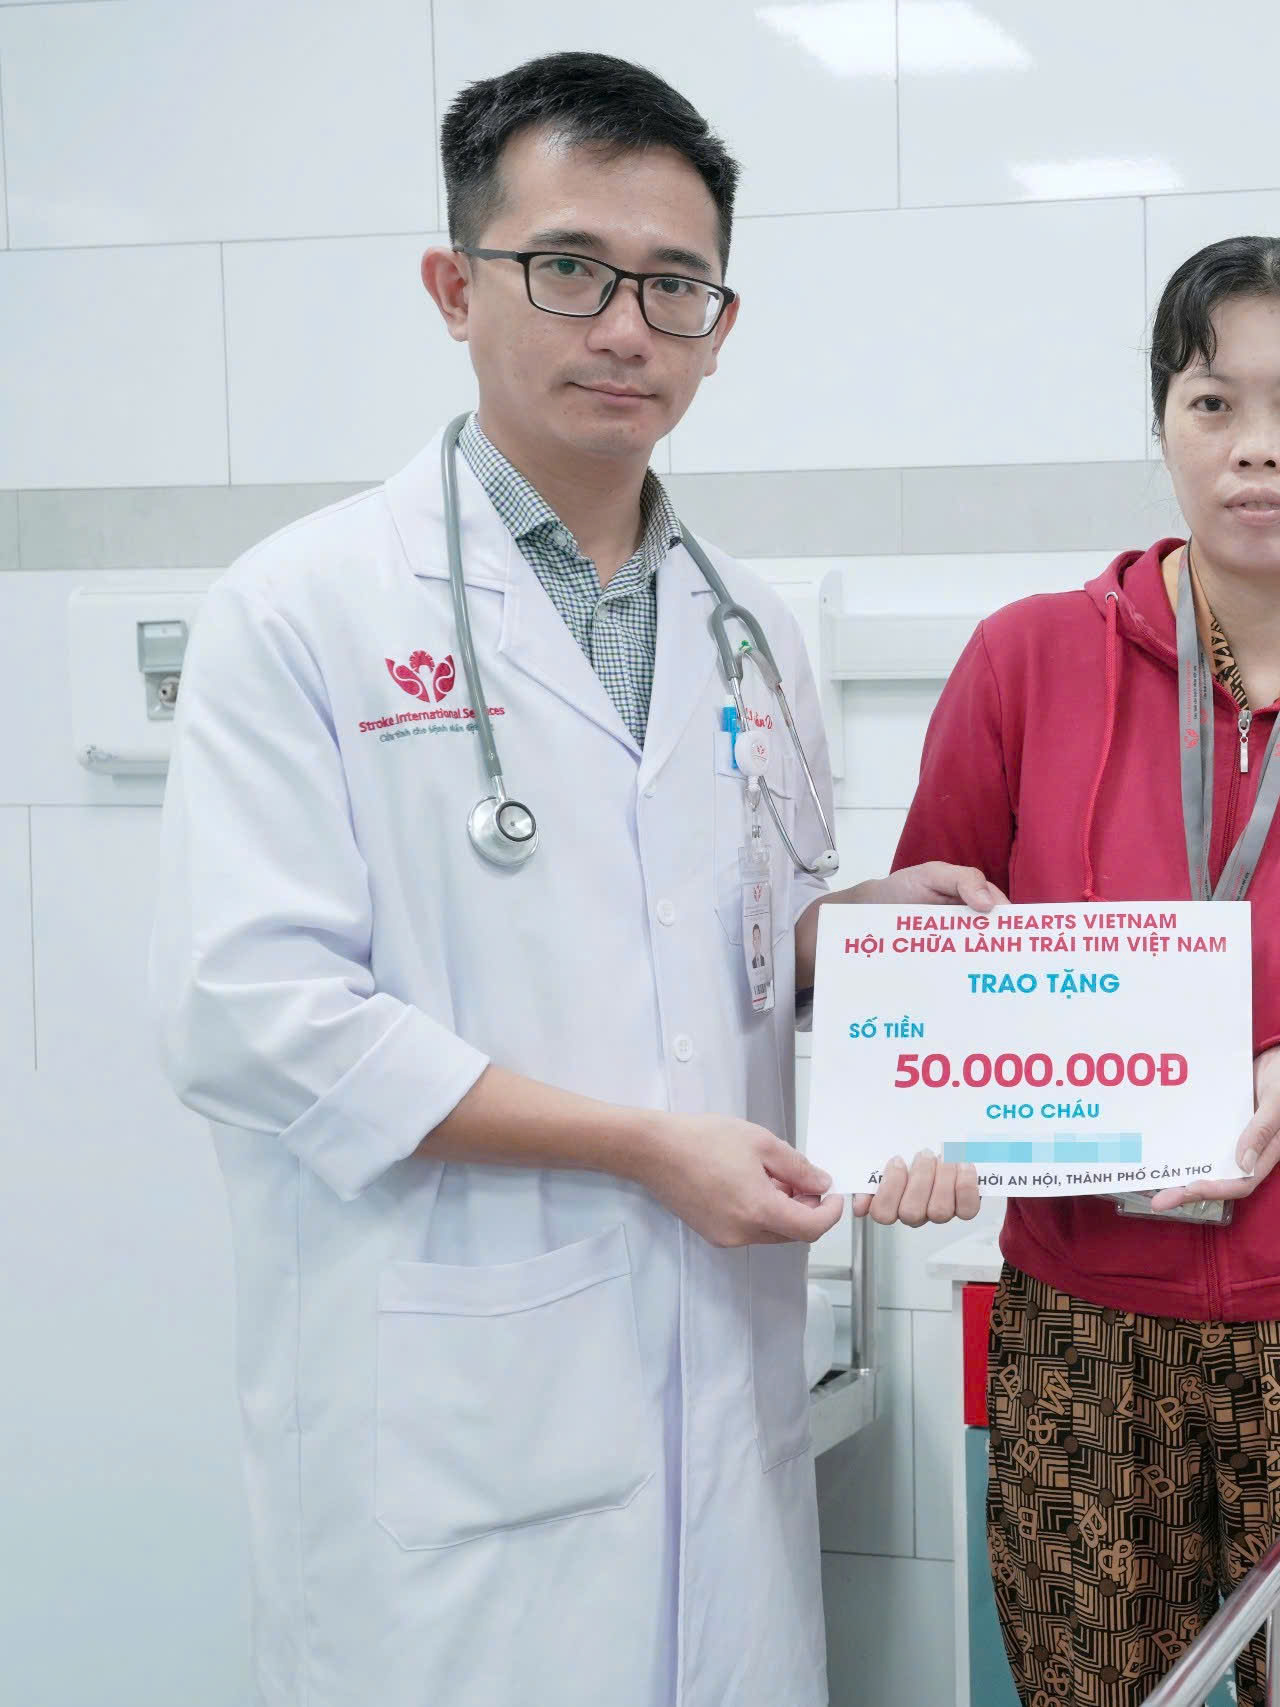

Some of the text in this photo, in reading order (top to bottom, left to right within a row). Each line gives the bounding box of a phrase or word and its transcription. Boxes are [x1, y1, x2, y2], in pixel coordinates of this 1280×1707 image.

[359, 706, 505, 733] Stroke International Seices
[896, 913, 1177, 931] HEALING HEARTS VIETNAM
[844, 931, 1227, 958] HỘI CHỮA LÀNH TRÁI TIM VIỆT NAM
[967, 968, 1120, 999] TRAO TẶNG
[849, 1014, 925, 1039] SỐ TIỀN
[894, 1052, 1189, 1088] 50.000.000Đ
[986, 1099, 1100, 1119] CHO CHÁU
[977, 1173, 1003, 1186] HỜI
[1008, 1175, 1027, 1185] AN
[1032, 1172, 1062, 1188] HỘI,
[1067, 1171, 1112, 1184] THÀNH
[1117, 1166, 1146, 1181] PHỐ
[1185, 1163, 1213, 1176] THƠ
[1012, 1369, 1074, 1473] B & W
[1155, 1396, 1185, 1432] B
[1140, 1464, 1177, 1500] B
[1017, 1506, 1038, 1541] B
[1079, 1504, 1107, 1549] B
